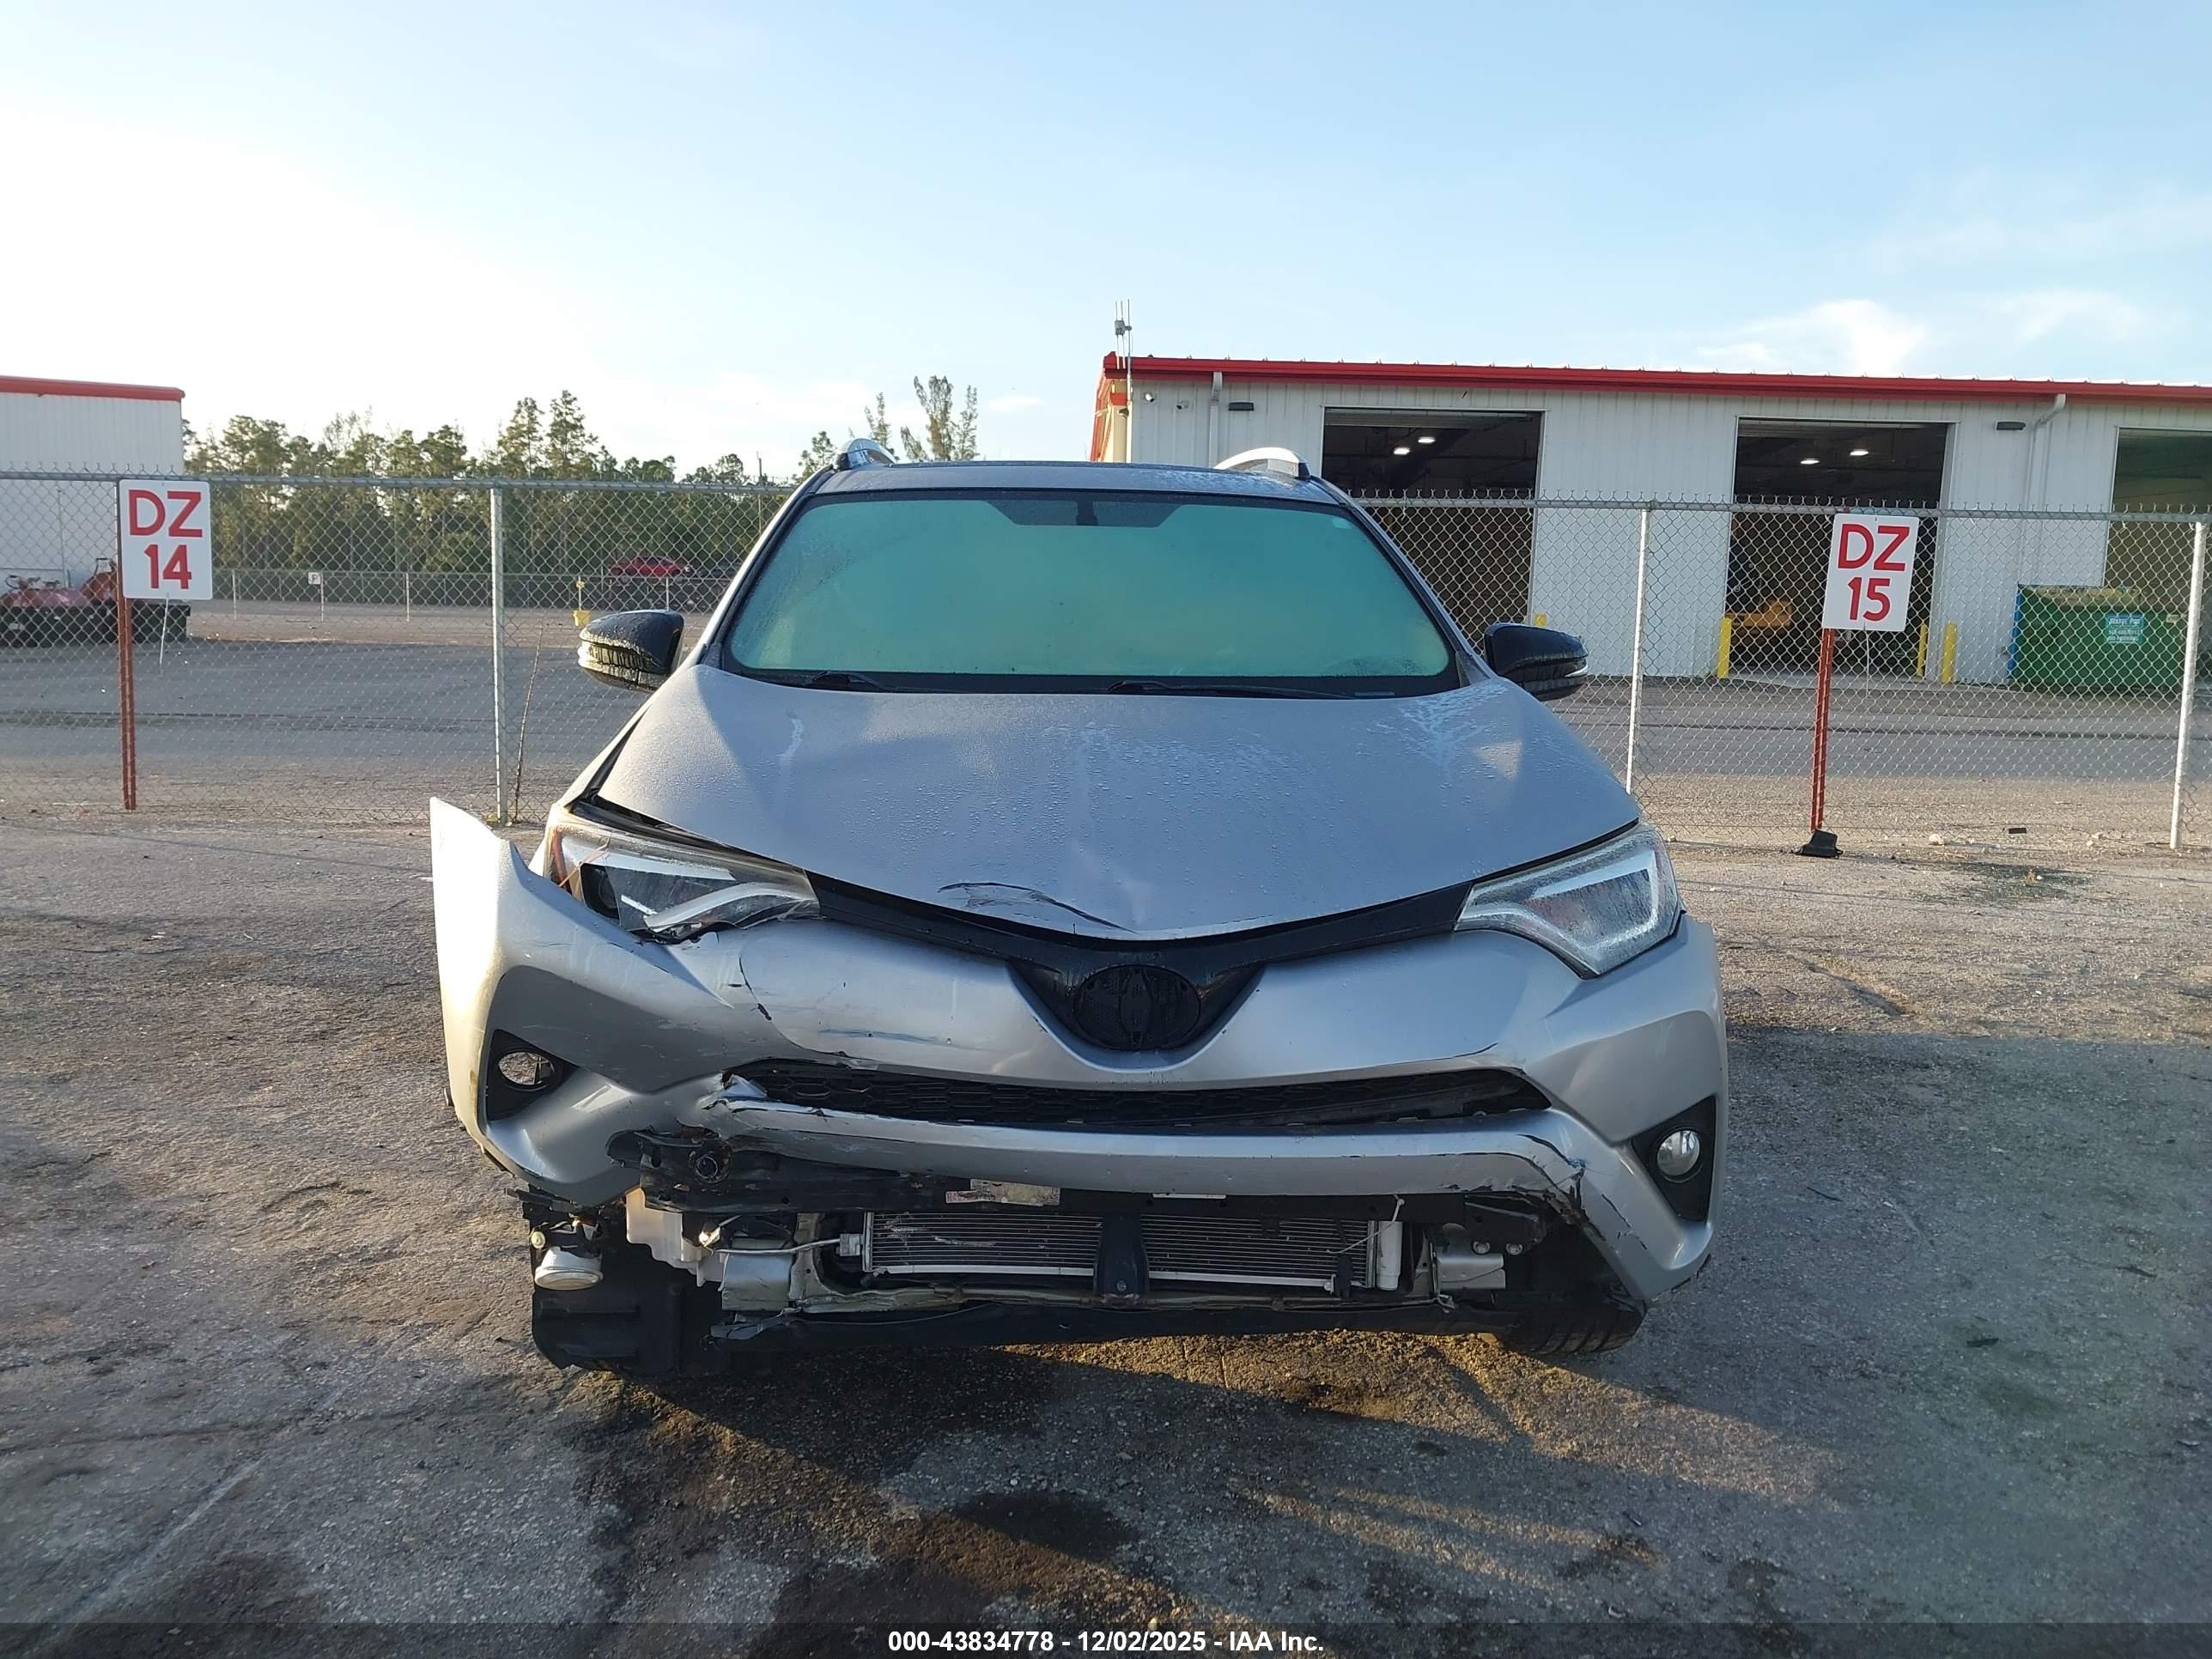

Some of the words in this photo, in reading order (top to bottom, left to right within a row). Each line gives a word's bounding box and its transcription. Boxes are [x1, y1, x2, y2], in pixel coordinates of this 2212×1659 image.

[128, 489, 203, 538] DZ
[143, 544, 192, 590] 14
[1837, 523, 1911, 572] DZ
[1847, 576, 1891, 622] 15
